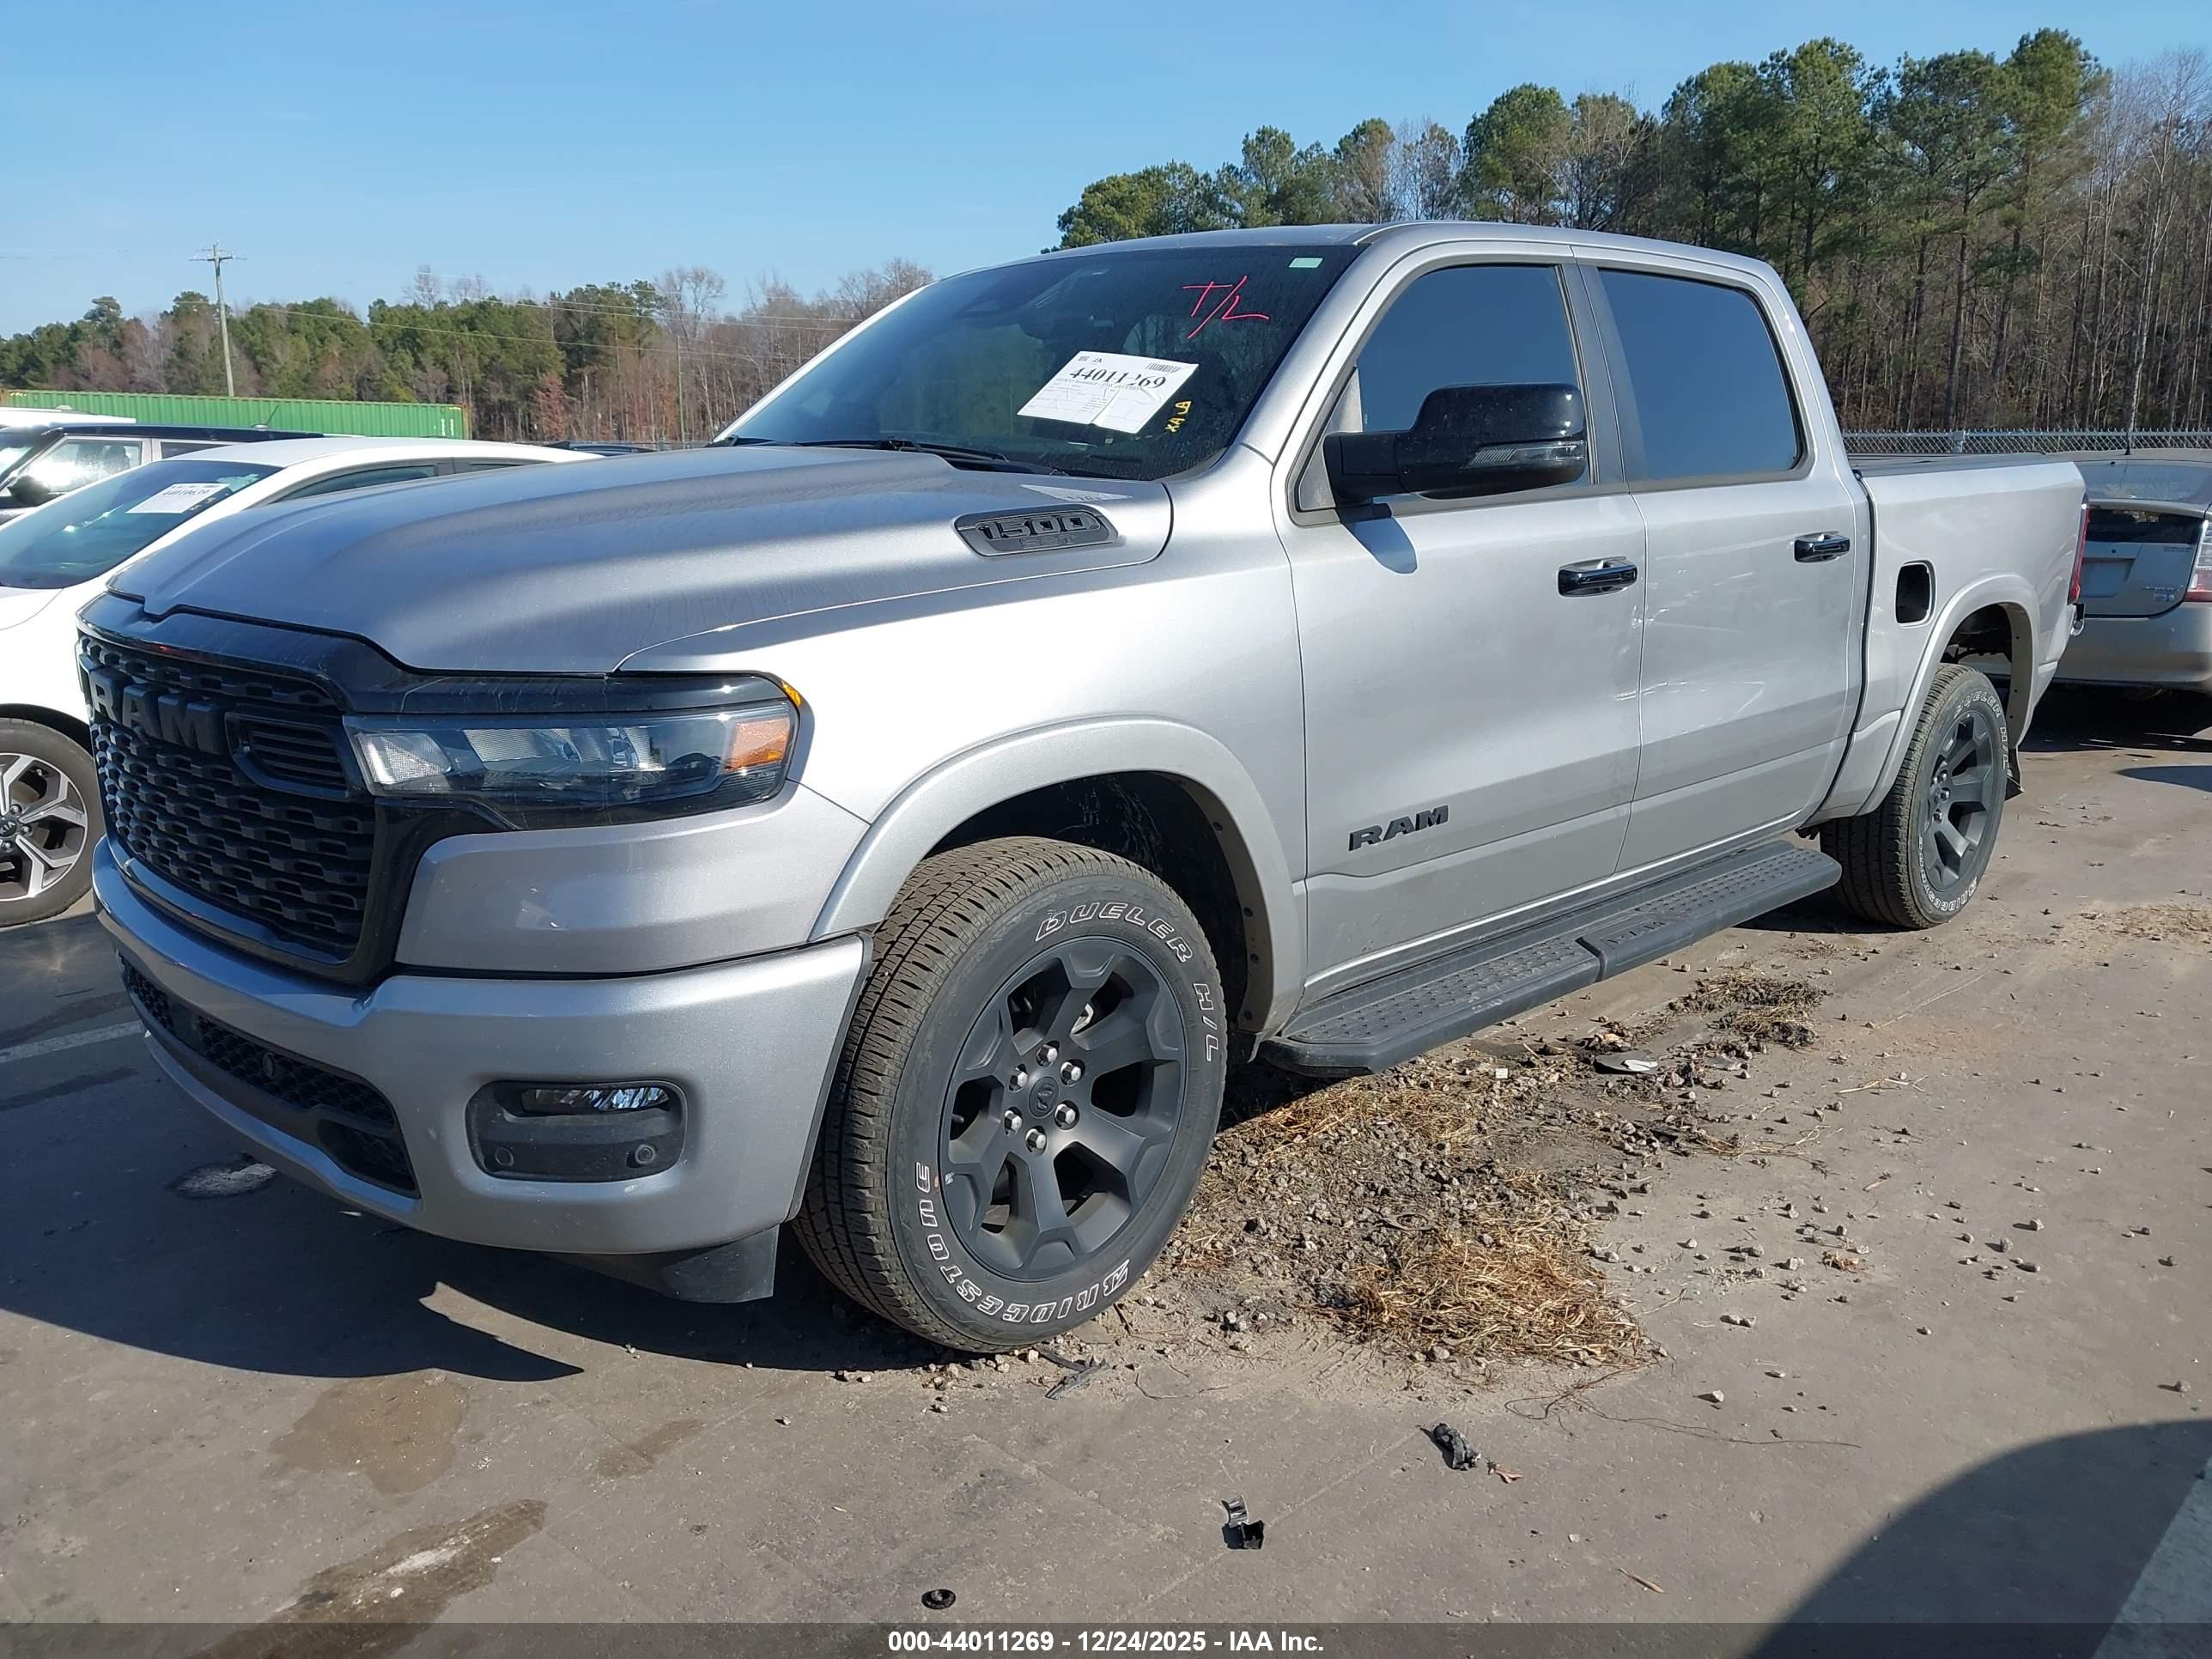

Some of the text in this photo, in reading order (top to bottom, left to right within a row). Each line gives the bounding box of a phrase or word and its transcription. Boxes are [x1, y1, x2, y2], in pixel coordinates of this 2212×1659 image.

[1182, 275, 1271, 340] T/L
[1069, 367, 1167, 389] 44011269
[977, 512, 1088, 539] 1500
[88, 667, 228, 756] RAM
[1348, 805, 1449, 853] RAM
[1035, 902, 1219, 1063] DUELER H/L
[914, 1160, 1131, 1324] BRIDGESTONE
